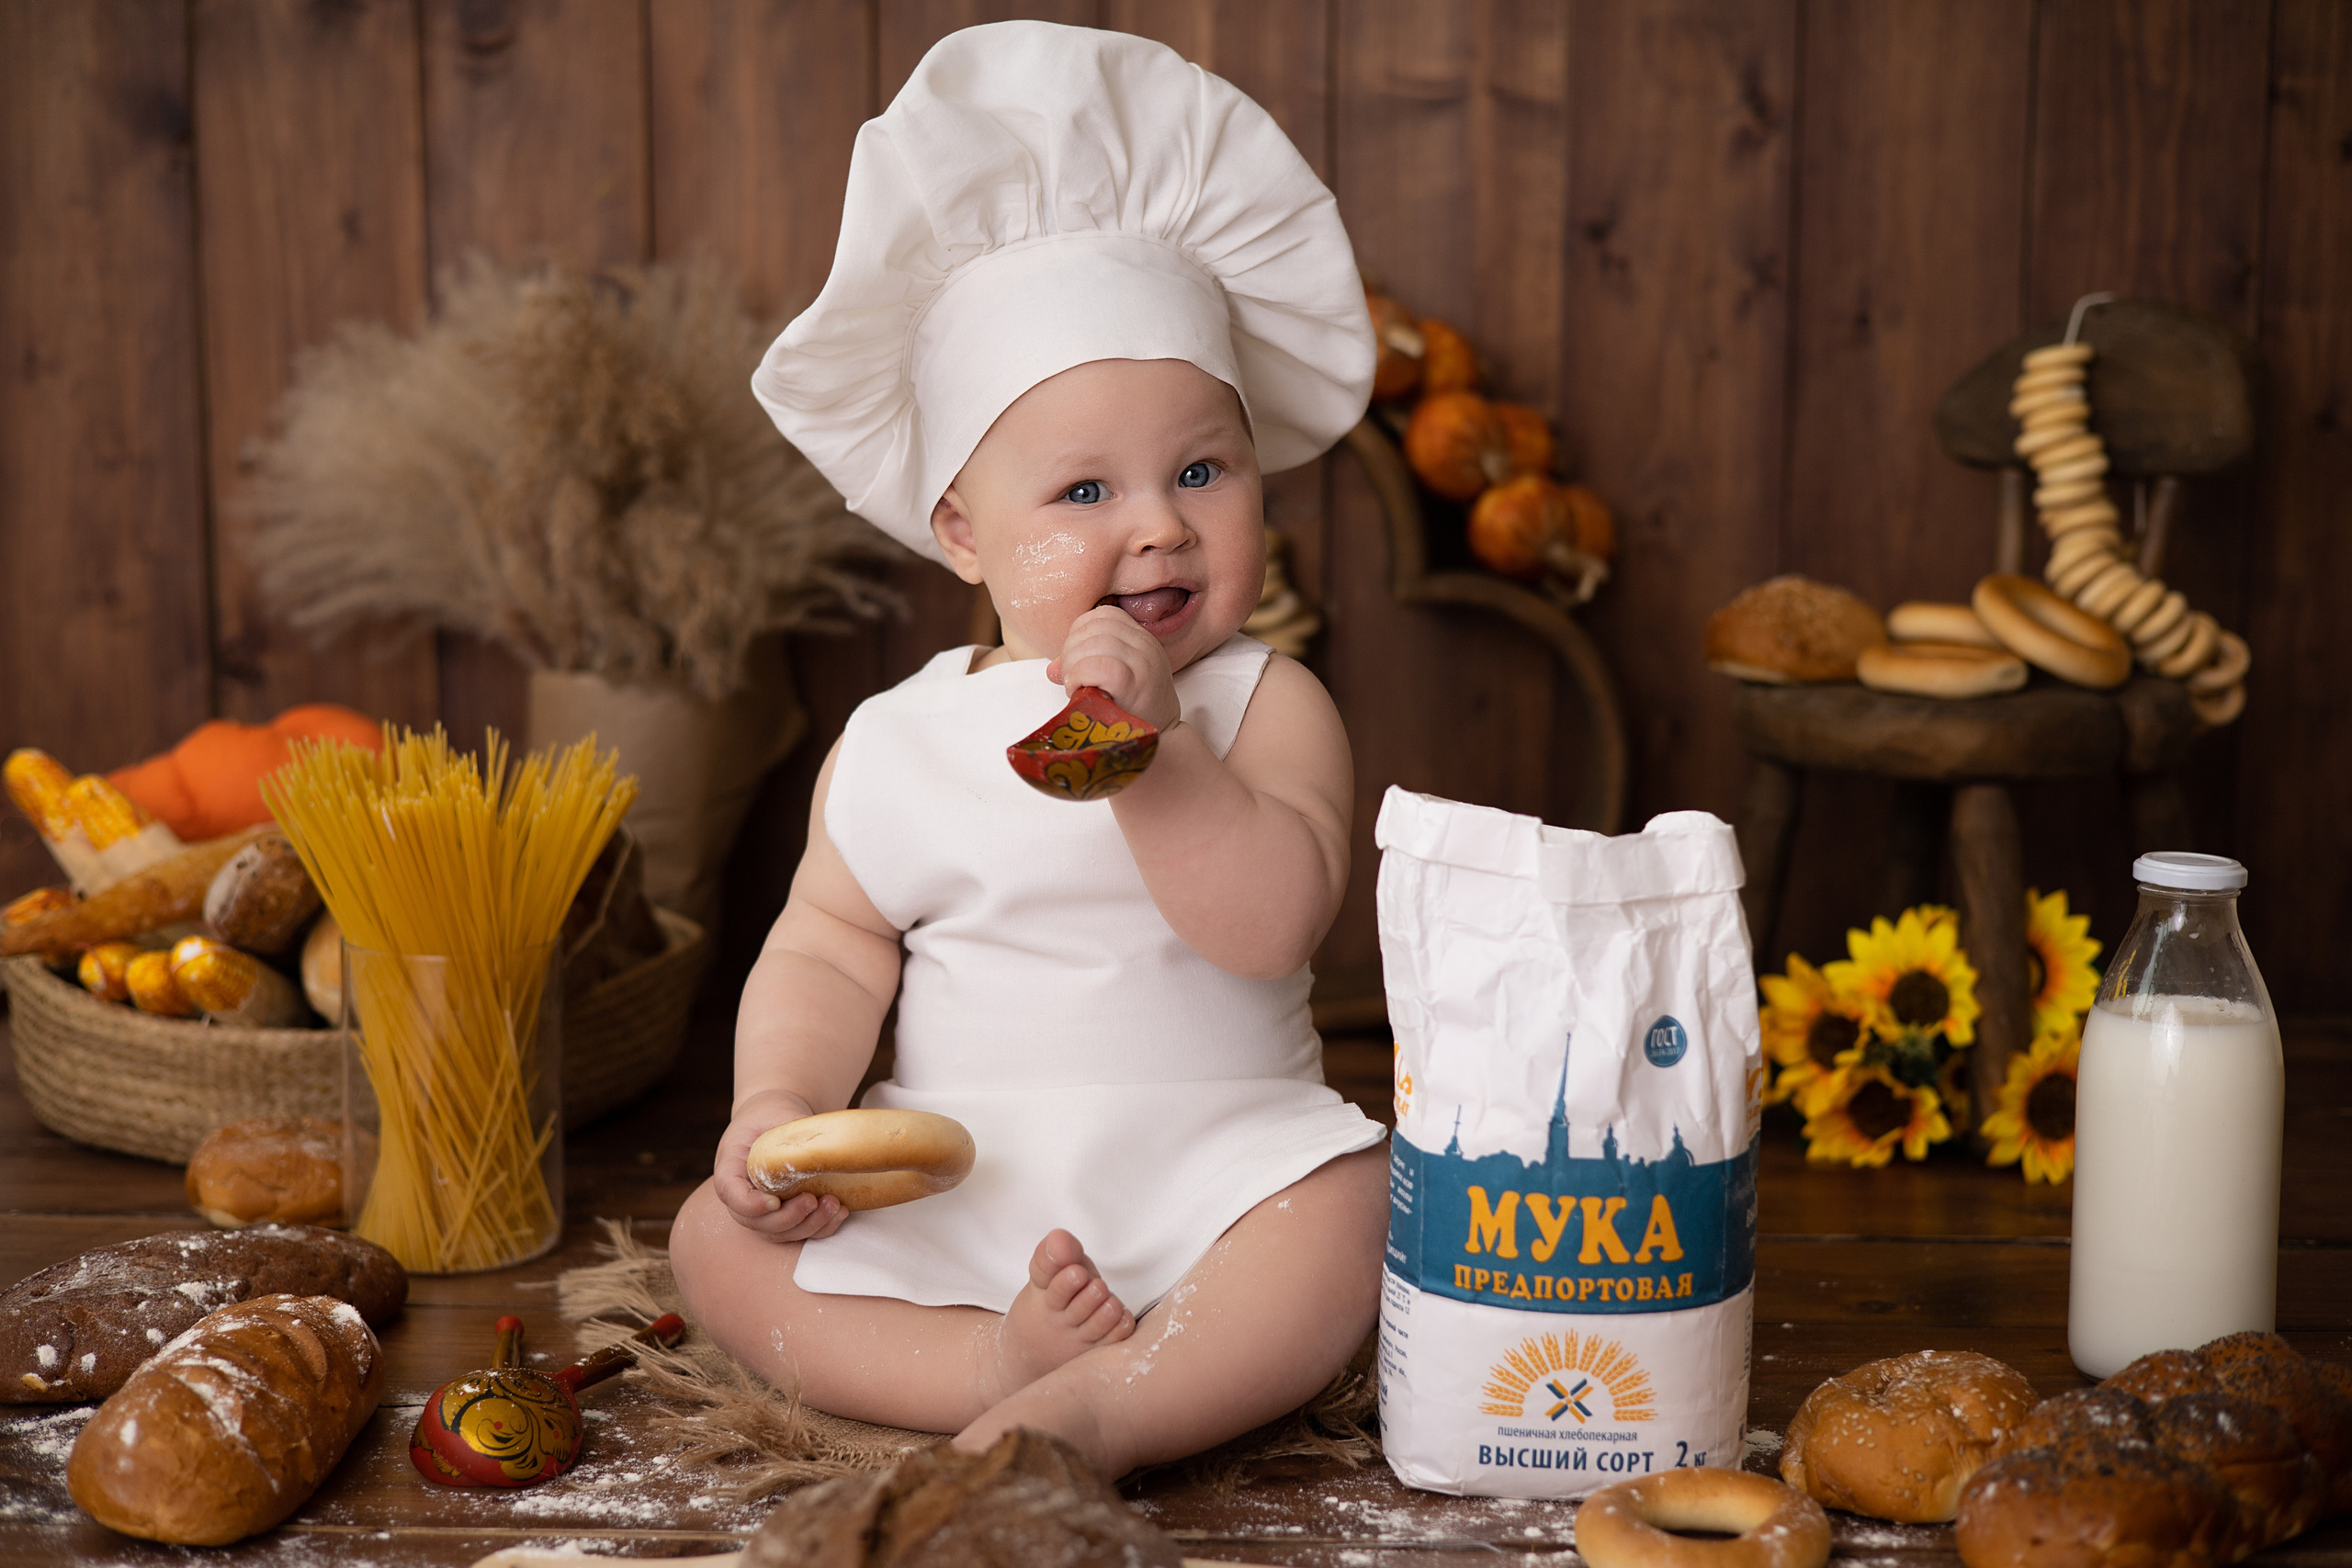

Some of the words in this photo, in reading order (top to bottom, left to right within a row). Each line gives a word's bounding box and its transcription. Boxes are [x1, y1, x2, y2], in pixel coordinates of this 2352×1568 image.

[1650, 1025, 1678, 1048] ГОСТ
[1464, 1185, 1685, 1265] МУКА
[1453, 1263, 1694, 1302] ПРЕДПОРТОВАЯ
[1498, 1426, 1556, 1439] пшеничная
[1559, 1428, 1637, 1445] хлебопекарная
[1478, 1444, 1588, 1471] ВЫСШИЙ
[1596, 1451, 1655, 1472] СОРТ
[1674, 1440, 1689, 1468] 2
[1694, 1451, 1707, 1467] кг
